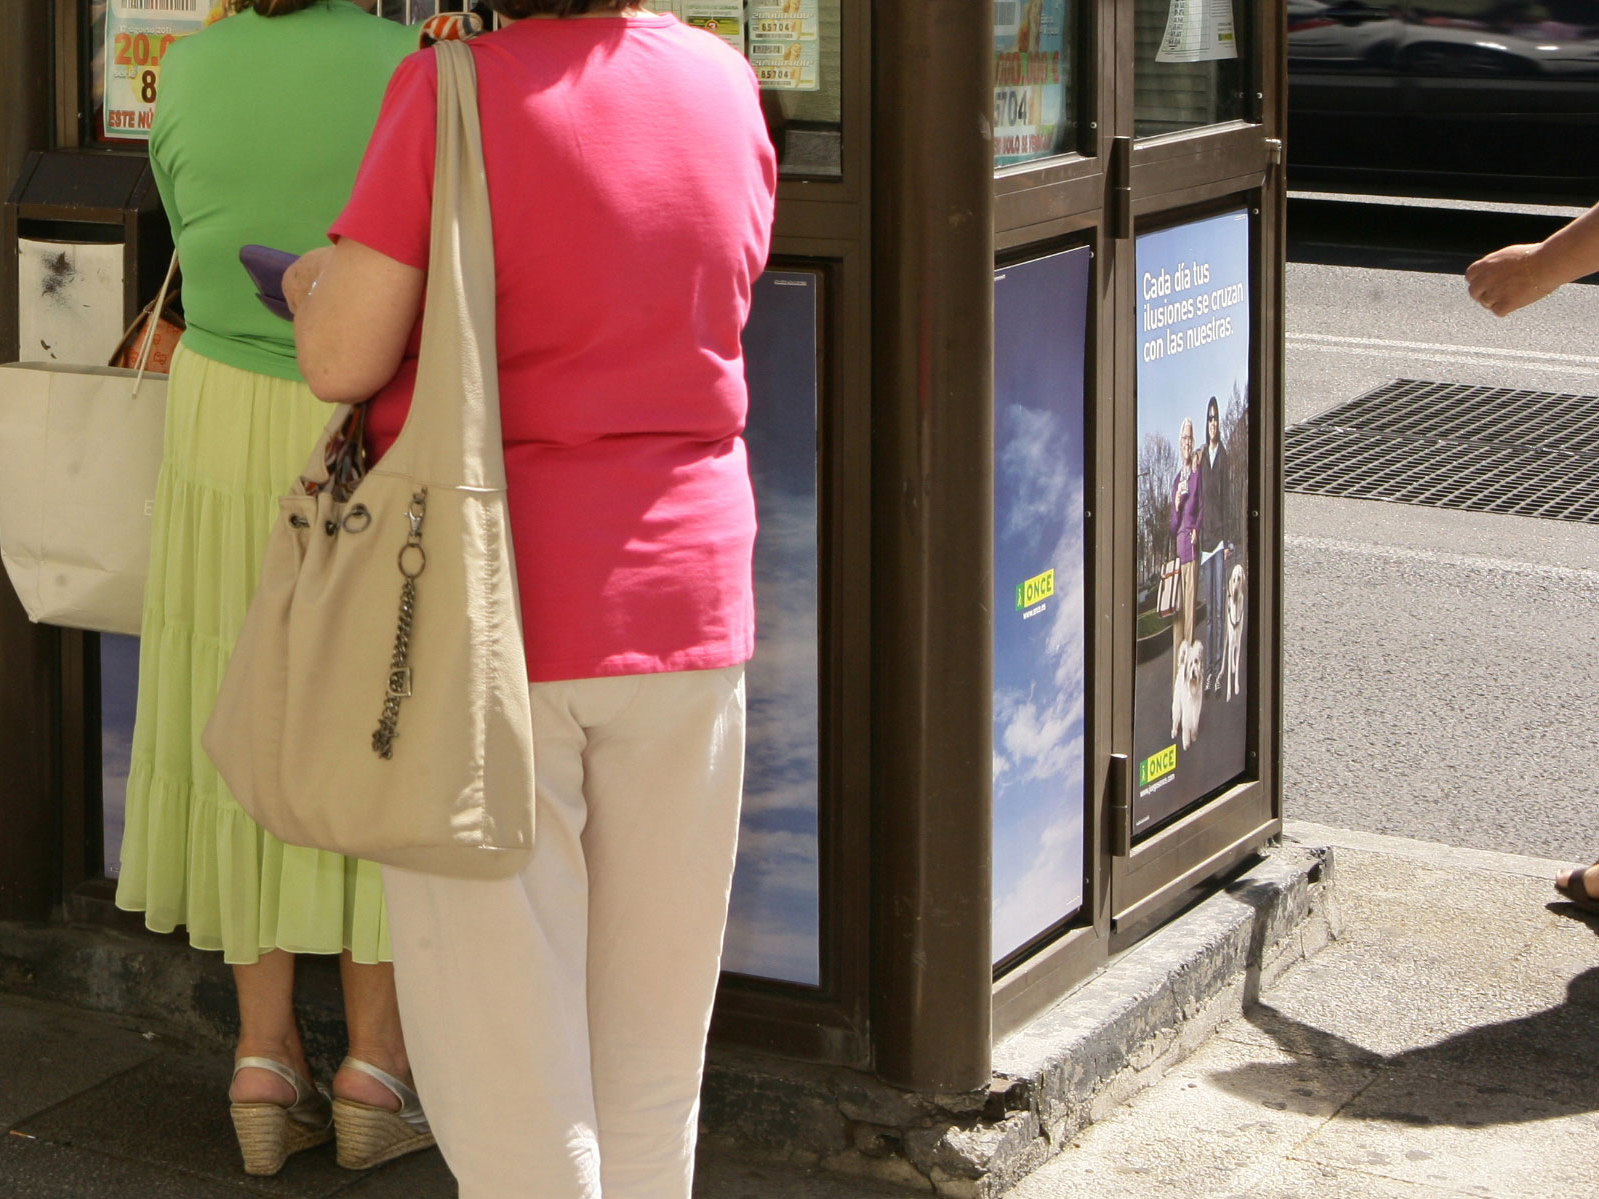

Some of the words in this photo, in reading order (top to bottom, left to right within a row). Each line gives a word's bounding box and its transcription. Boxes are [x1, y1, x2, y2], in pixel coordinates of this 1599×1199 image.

[142, 70, 157, 103] 8
[108, 109, 135, 128] ESTE
[138, 107, 154, 129] NÚ
[1143, 268, 1171, 300] Cada
[1174, 262, 1191, 292] día
[1193, 262, 1210, 286] tus
[1143, 298, 1194, 331] ilusiones
[1196, 294, 1209, 315] se
[1211, 283, 1243, 311] cruzan
[1143, 338, 1163, 362] con
[1167, 328, 1183, 355] las
[1187, 316, 1233, 349] nuestras.
[1026, 573, 1052, 602] ONCE
[1149, 749, 1174, 777] ONCE
